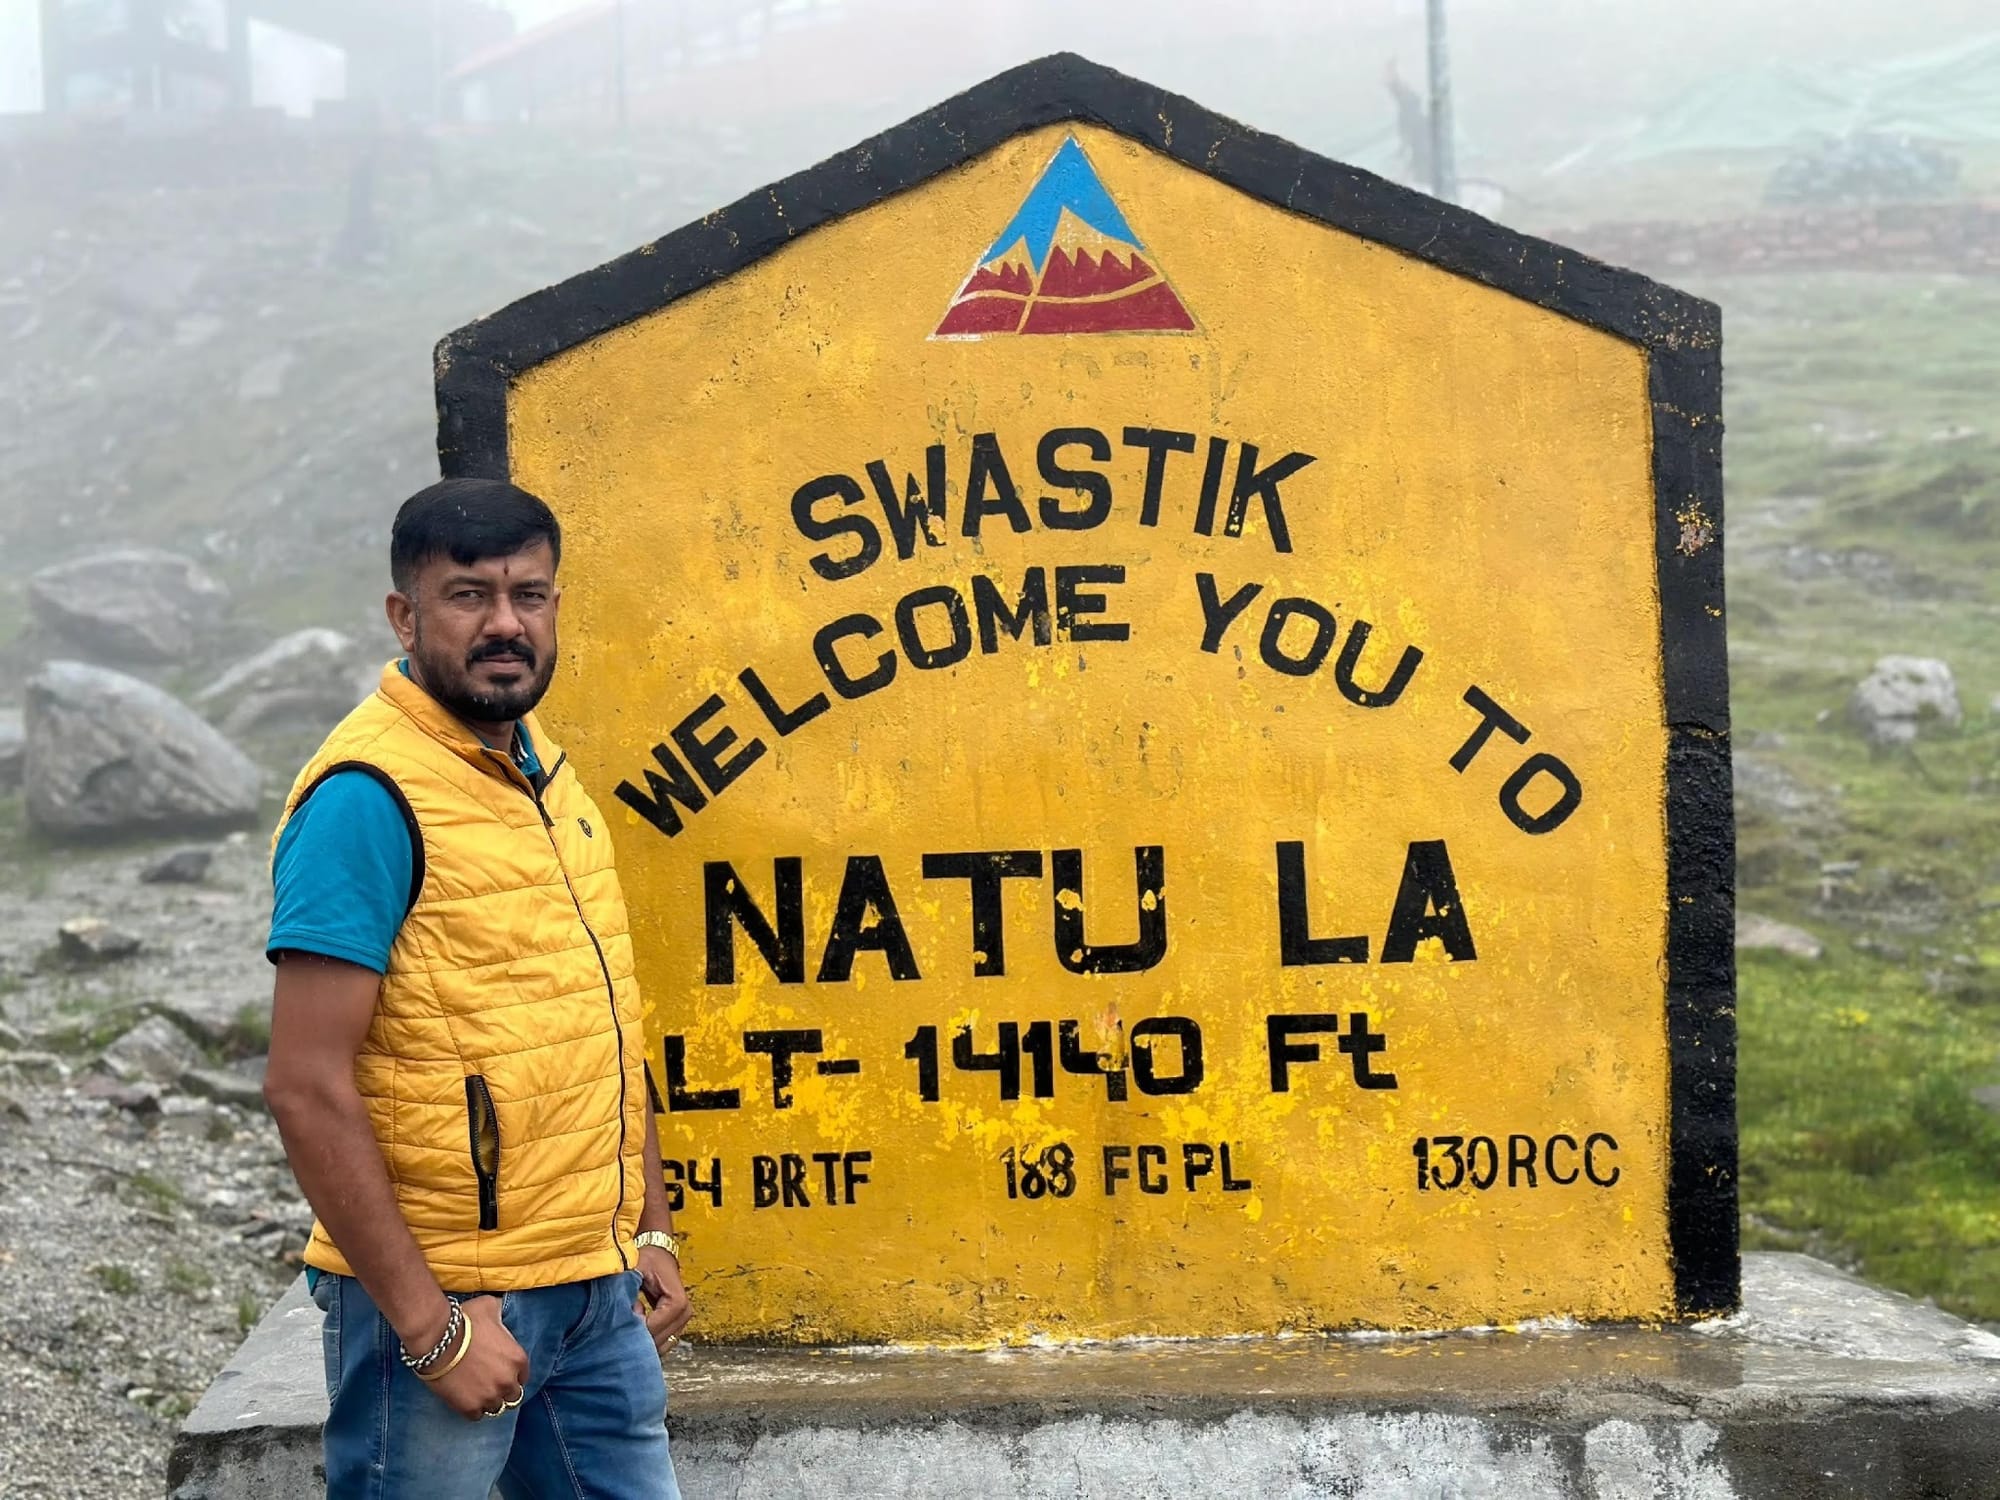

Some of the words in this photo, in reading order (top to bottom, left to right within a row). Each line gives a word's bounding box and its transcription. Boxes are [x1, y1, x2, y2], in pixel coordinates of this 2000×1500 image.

[791, 426, 1318, 581] SWASTIK
[614, 565, 1130, 838] WELCOME
[1195, 572, 1424, 708] YOU
[1448, 684, 1583, 835] TO
[703, 845, 1167, 985] NATU
[1276, 839, 1477, 967] LA
[904, 1016, 1204, 1102] 14140
[1266, 1012, 1399, 1093] Ft
[752, 1151, 872, 1208] BRTF
